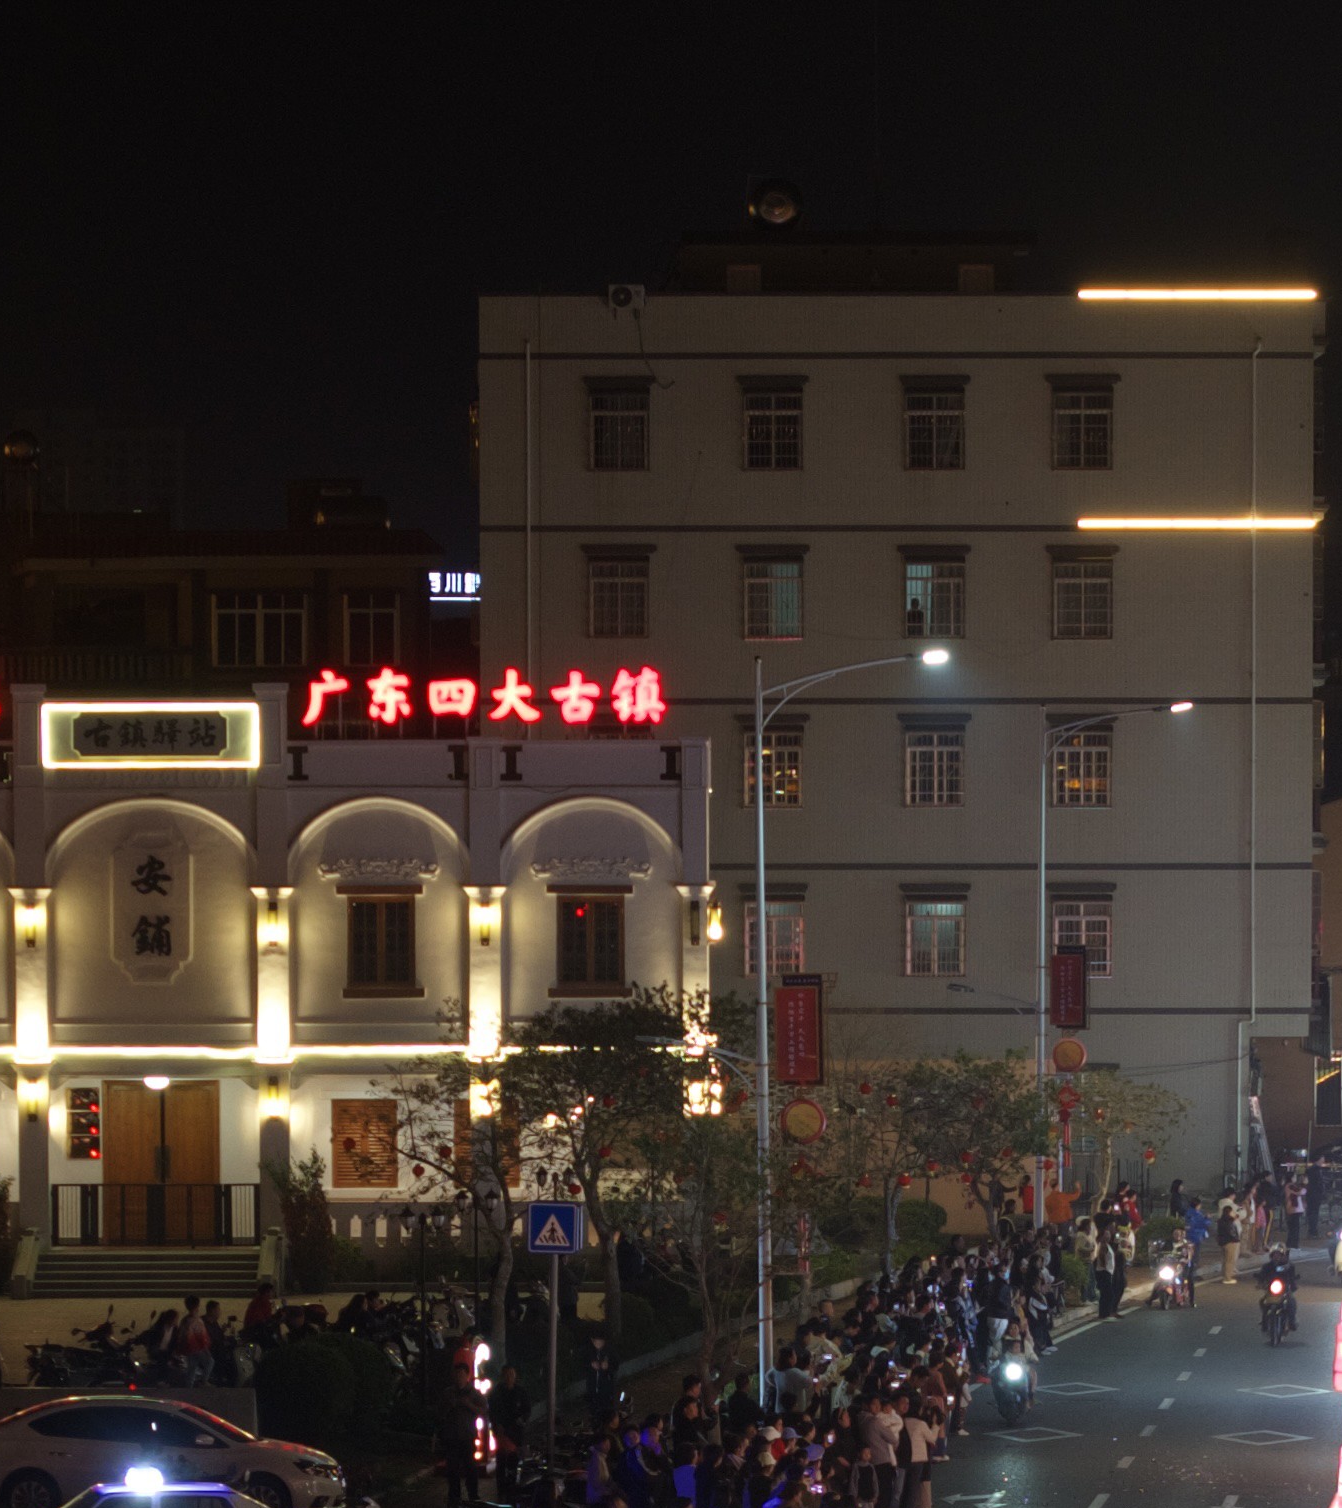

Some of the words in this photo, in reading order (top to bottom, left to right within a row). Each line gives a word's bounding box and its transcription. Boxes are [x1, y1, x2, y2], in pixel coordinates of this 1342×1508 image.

[301, 666, 668, 727] 广东四大古镇
[131, 855, 173, 956] 安鋪
